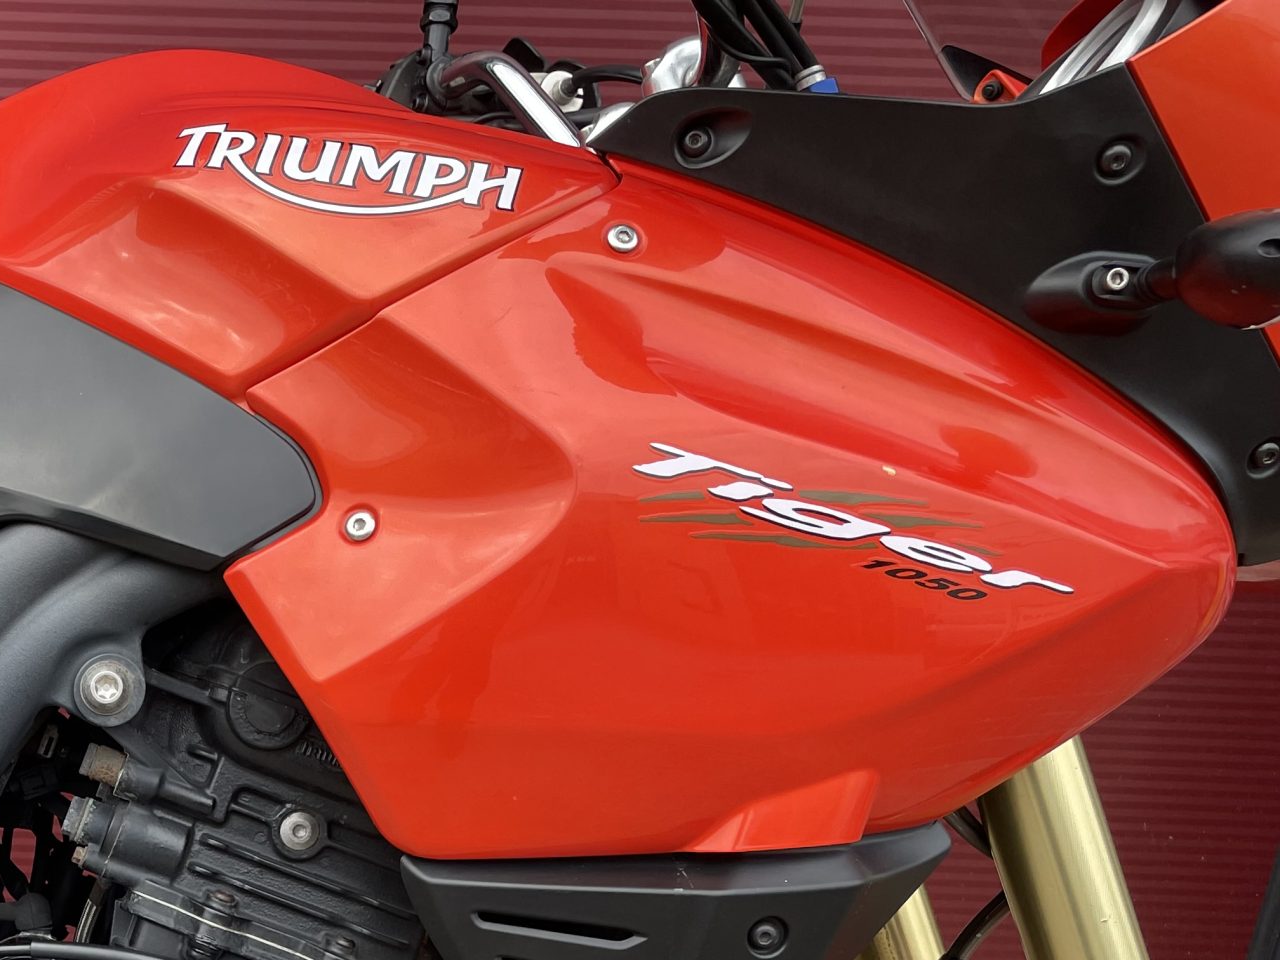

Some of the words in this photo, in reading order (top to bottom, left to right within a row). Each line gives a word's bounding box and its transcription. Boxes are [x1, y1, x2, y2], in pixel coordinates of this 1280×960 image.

[174, 123, 523, 215] TRIUMPH
[632, 442, 1075, 594] Tiger
[858, 559, 988, 600] 1050
